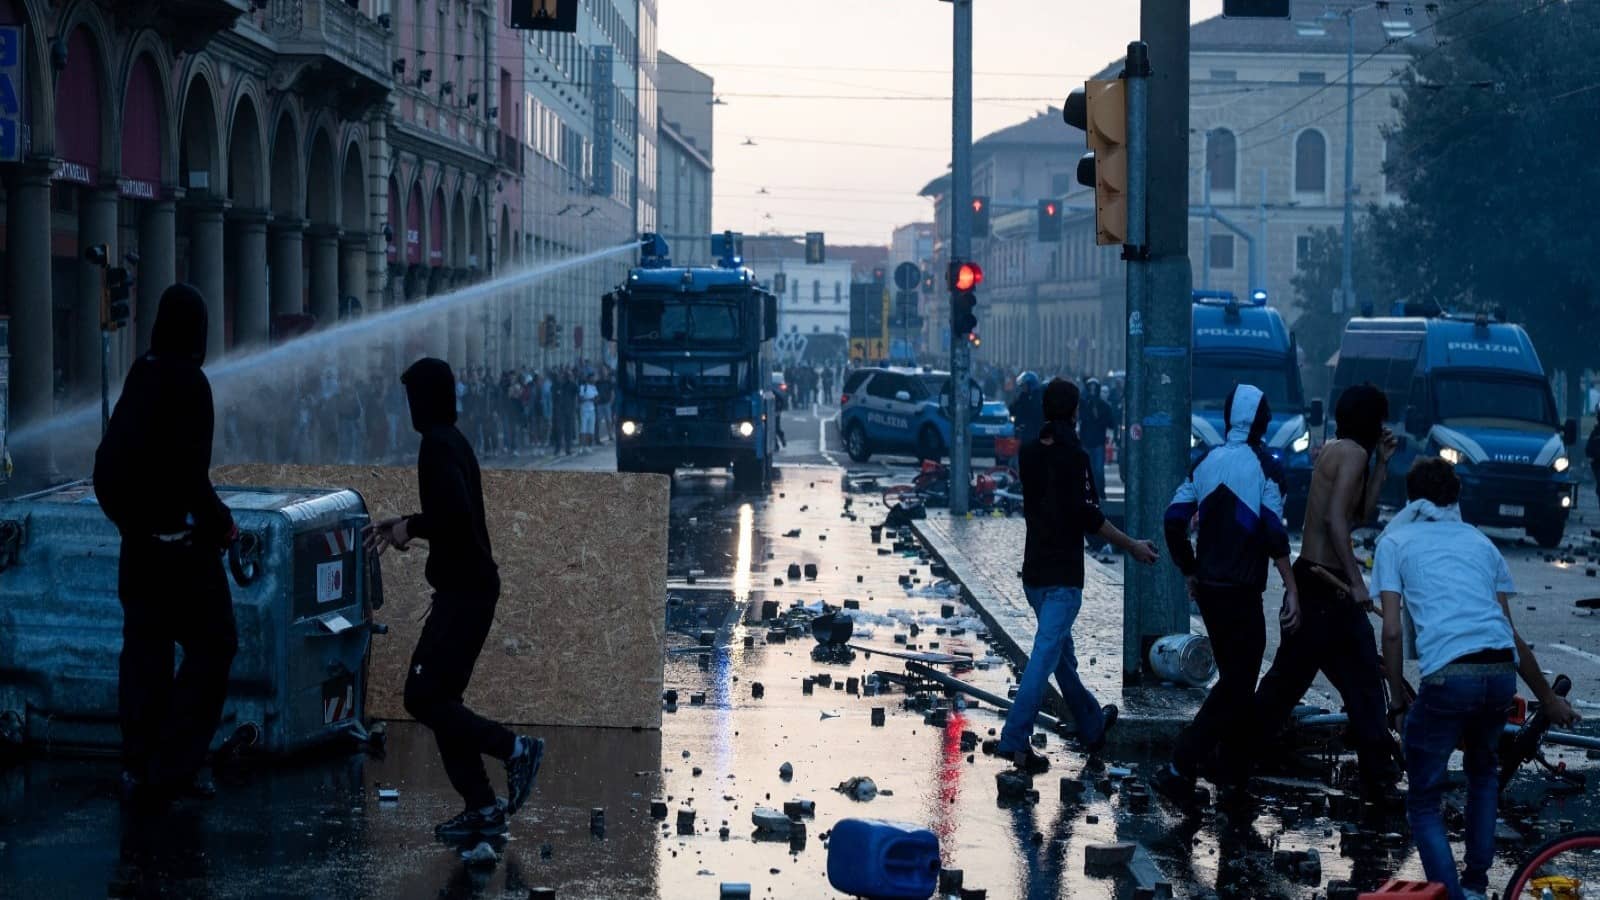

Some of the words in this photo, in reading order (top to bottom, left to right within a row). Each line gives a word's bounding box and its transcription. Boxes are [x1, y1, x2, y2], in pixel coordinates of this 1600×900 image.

[1196, 327, 1271, 339] POLIZIA
[1447, 341, 1520, 354] POLIZIA
[868, 412, 908, 429] POLIZIA
[1495, 453, 1530, 464] IVECO
